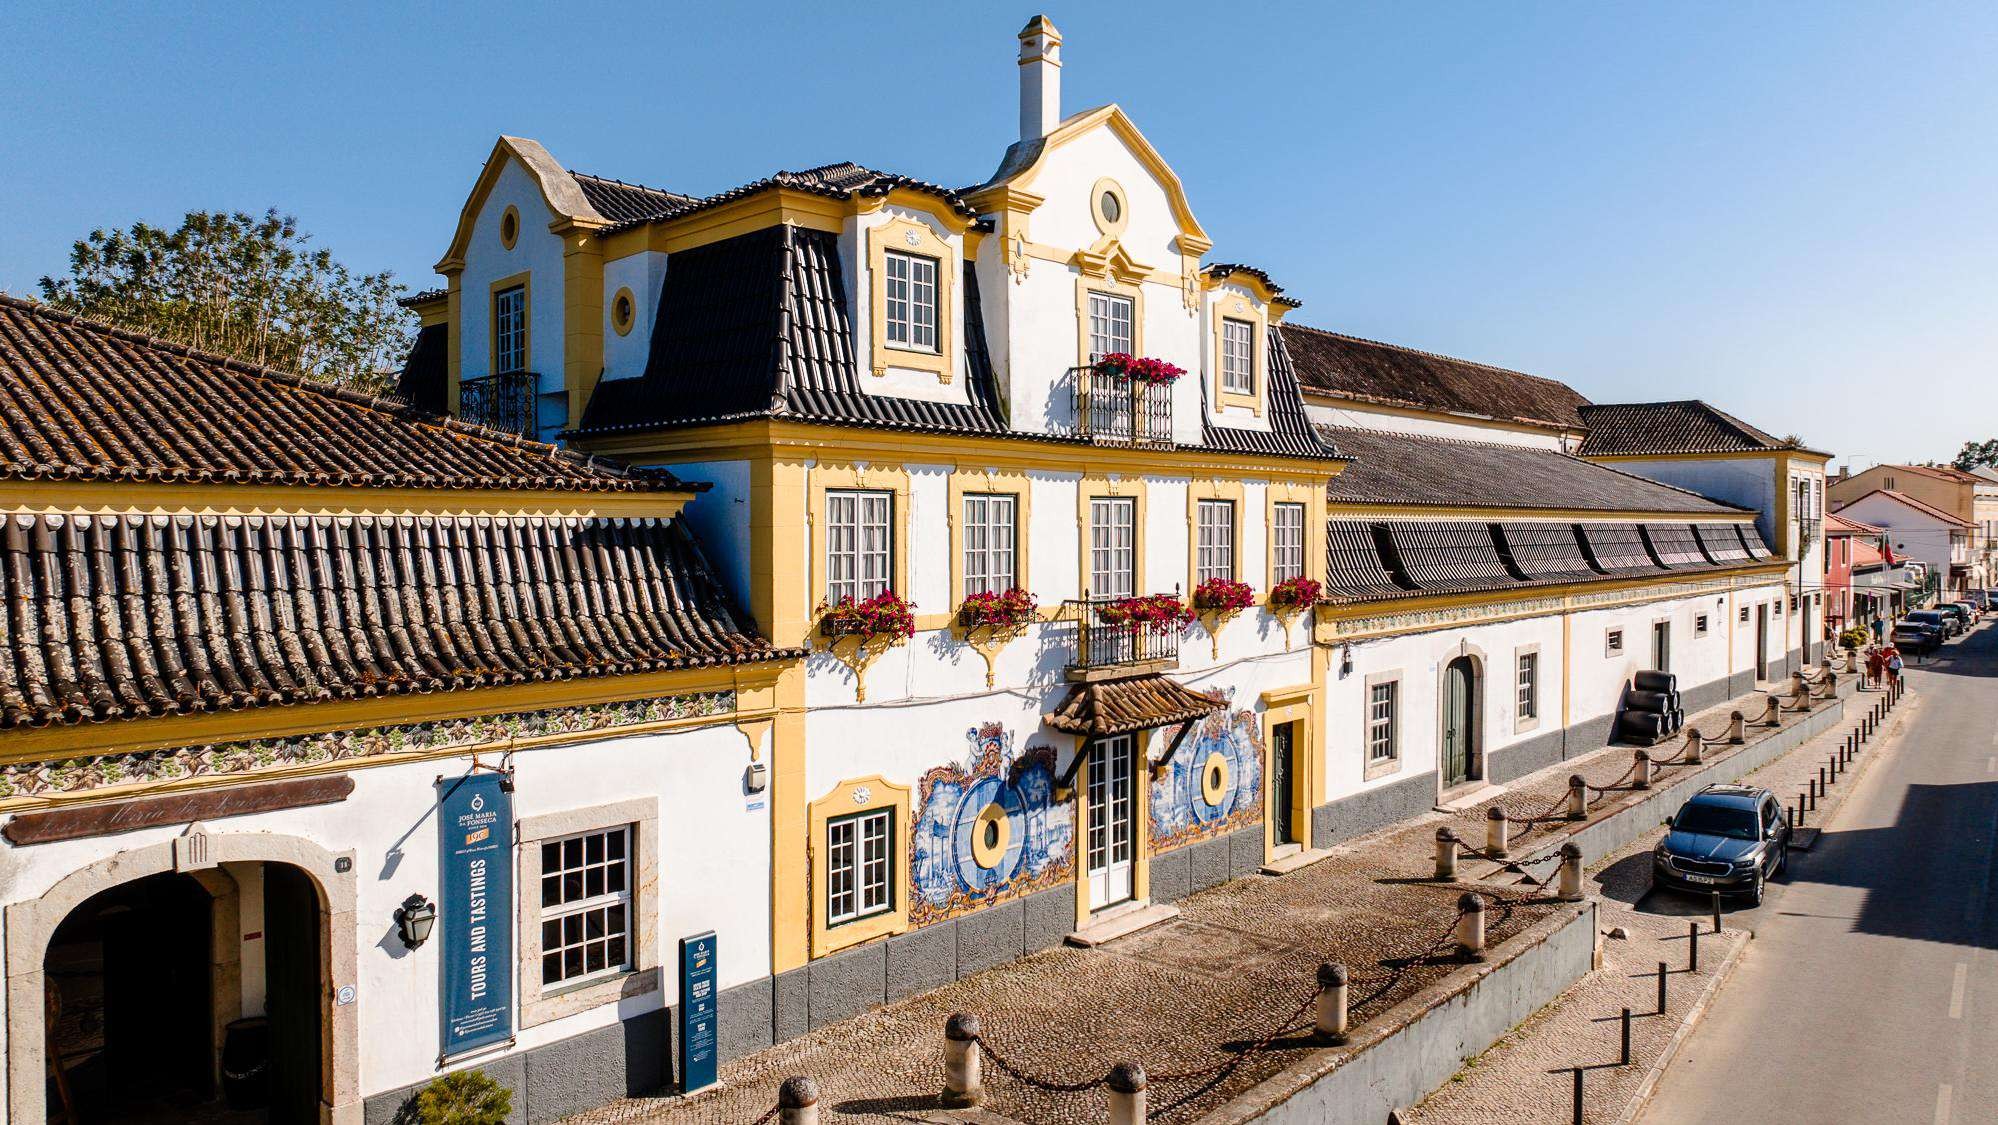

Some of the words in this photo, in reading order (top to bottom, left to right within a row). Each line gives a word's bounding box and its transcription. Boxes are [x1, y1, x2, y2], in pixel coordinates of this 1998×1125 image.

[471, 859, 486, 924] TASTINGS
[471, 926, 486, 952] AND
[471, 955, 487, 1000] TOURS
